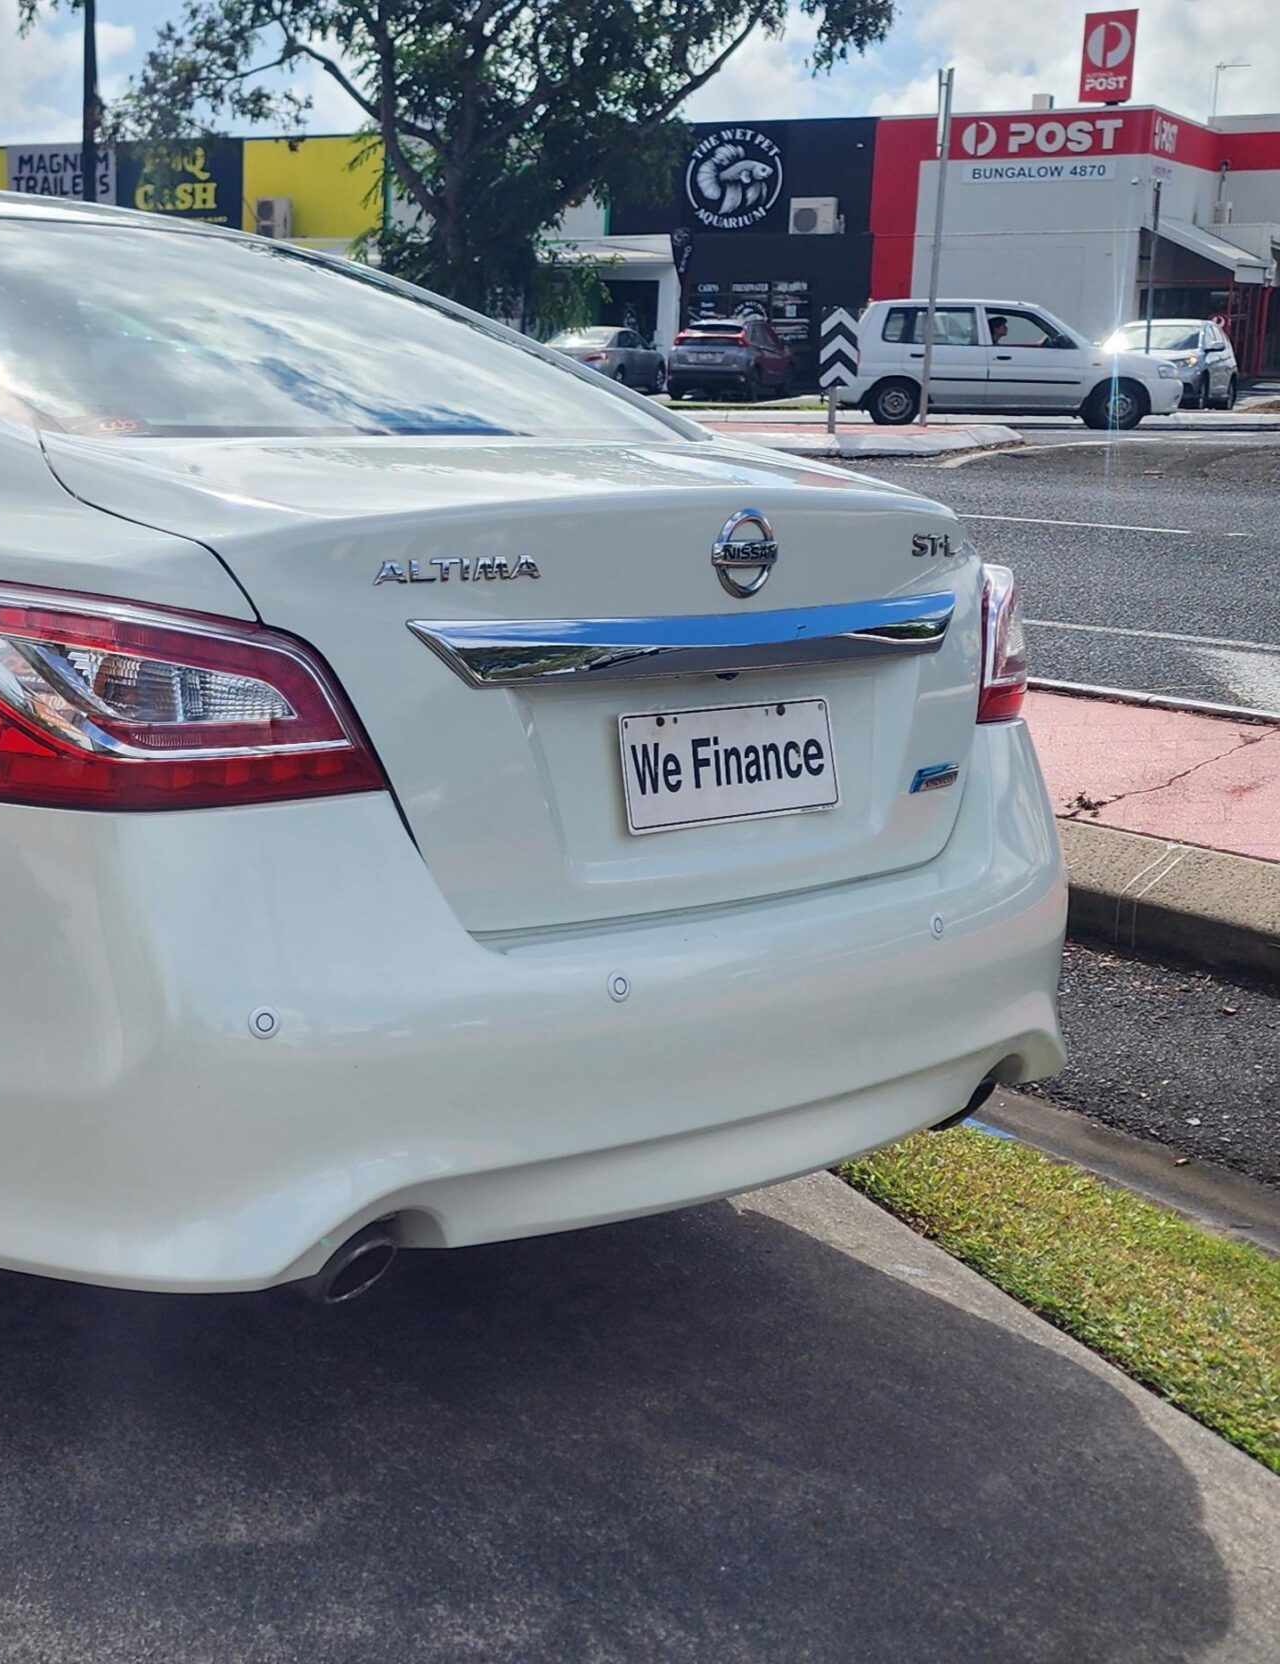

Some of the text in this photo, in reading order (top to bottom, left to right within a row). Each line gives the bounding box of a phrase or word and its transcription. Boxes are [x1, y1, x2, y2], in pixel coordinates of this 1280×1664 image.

[1084, 76, 1128, 91] POST
[692, 128, 781, 158] THE WET PET
[1007, 119, 1124, 153] POST
[18, 152, 109, 174] MAGNM
[972, 164, 1106, 180] BUNGALOW 4870
[12, 174, 110, 196] TRAILES
[695, 206, 767, 228] AQUARIUM
[722, 543, 776, 561] NISSAN
[373, 554, 541, 585] ALTIMA
[630, 736, 825, 795] We Finance
